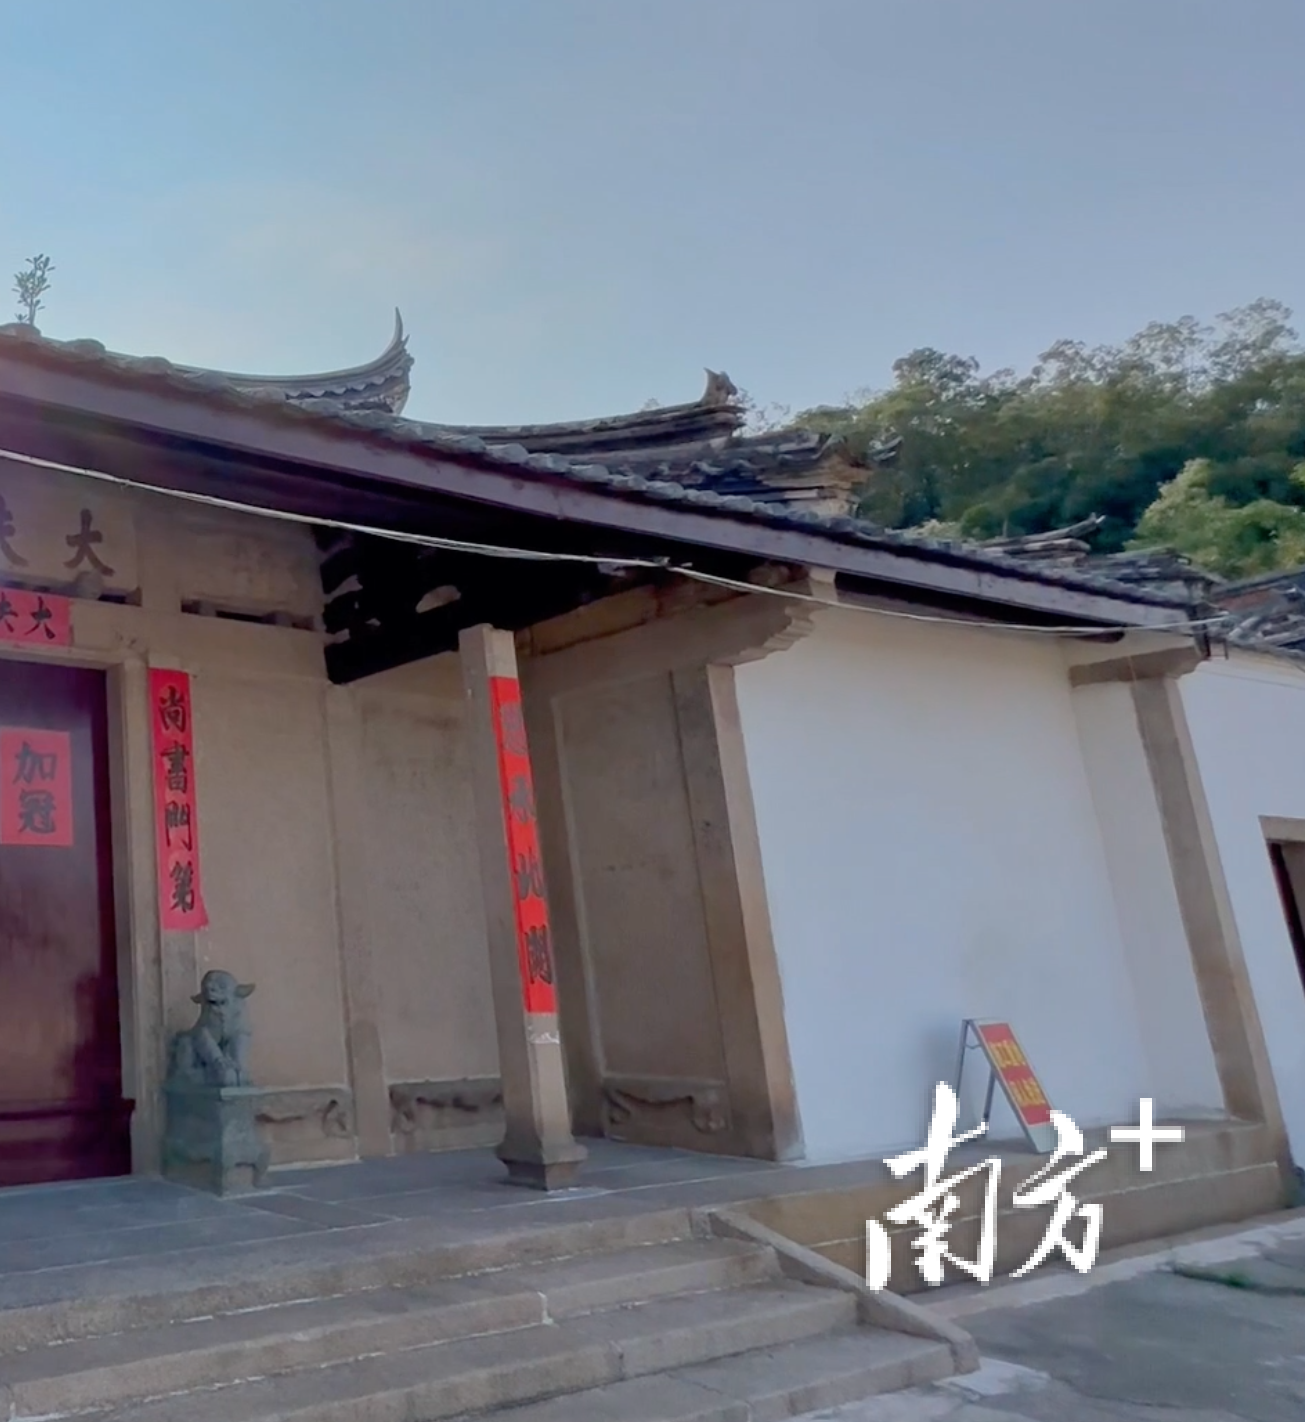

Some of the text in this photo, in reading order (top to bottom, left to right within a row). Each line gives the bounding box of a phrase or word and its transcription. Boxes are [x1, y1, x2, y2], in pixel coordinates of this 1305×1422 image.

[12, 741, 58, 834] 加冠
[158, 685, 195, 914] 尚書門第
